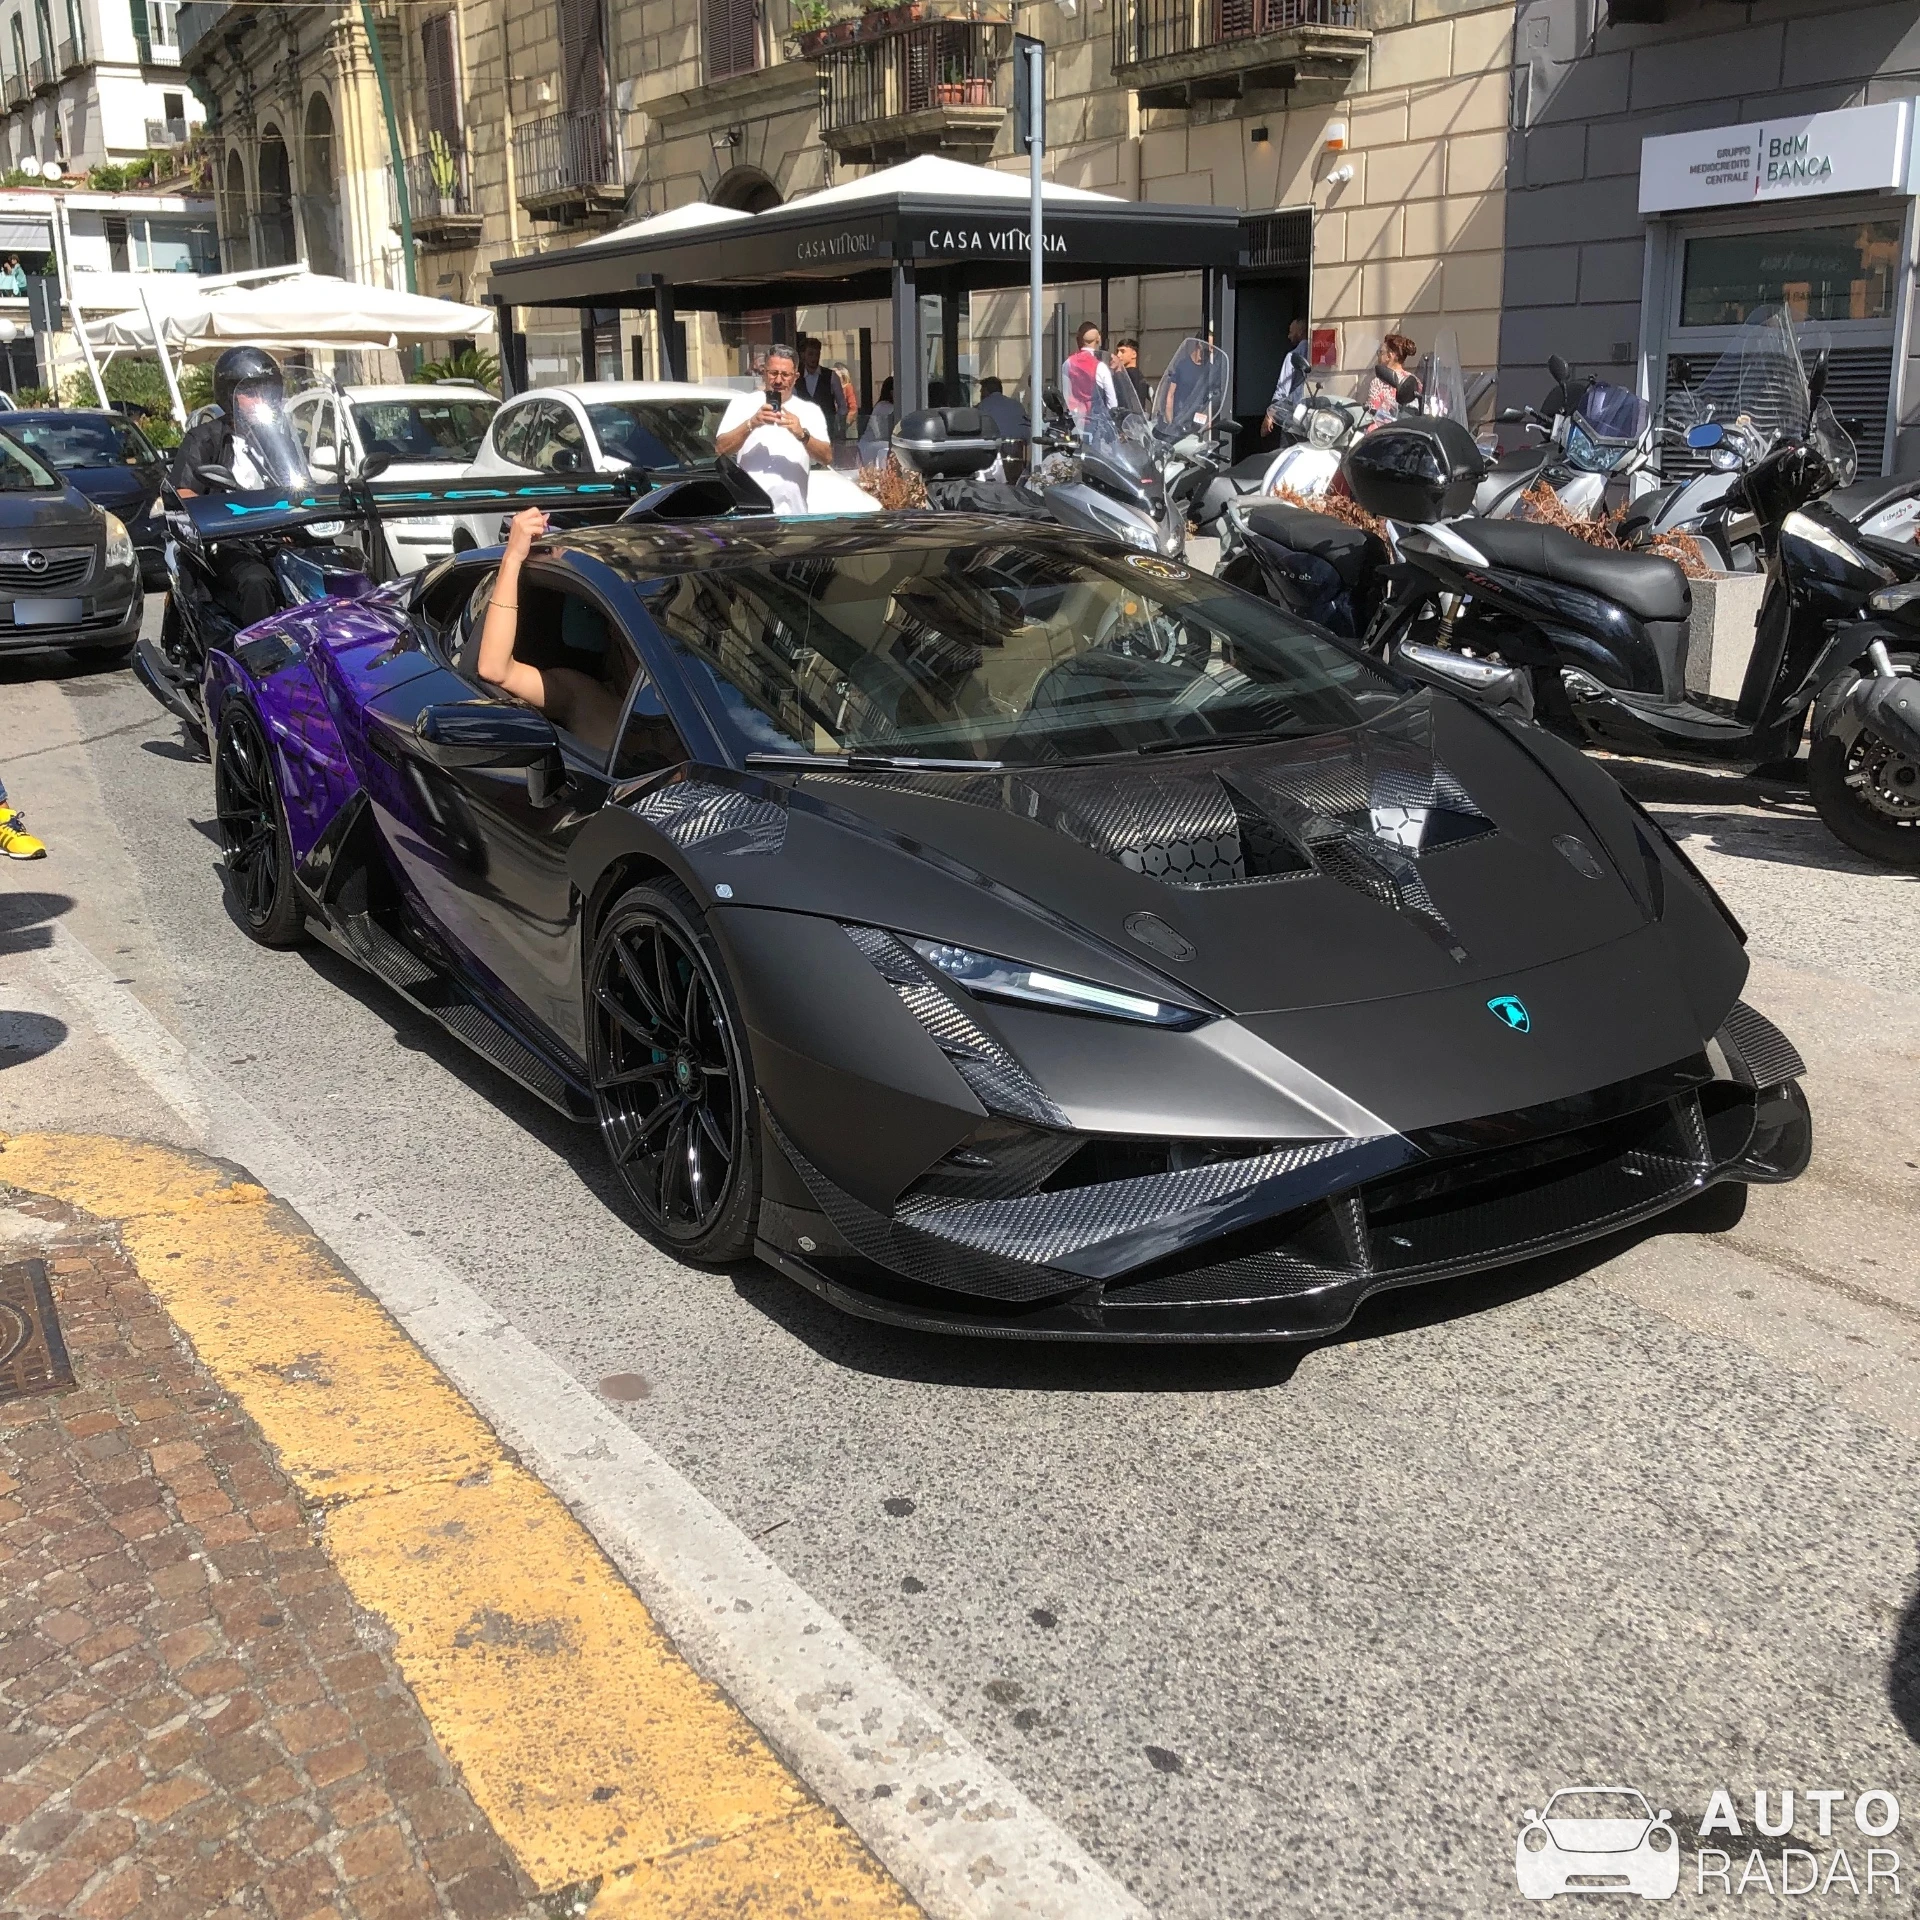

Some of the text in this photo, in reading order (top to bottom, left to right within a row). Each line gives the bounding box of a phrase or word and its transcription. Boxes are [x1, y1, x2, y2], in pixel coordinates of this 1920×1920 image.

[1716, 145, 1751, 159] GRUPPO
[1769, 134, 1809, 158] BdM
[1689, 158, 1750, 174] MEDIOCREDITO
[1767, 155, 1832, 182] BANCA
[1705, 171, 1749, 185] CENTRALE
[797, 232, 876, 259] CASA VITTORIA
[929, 229, 982, 249] CASA
